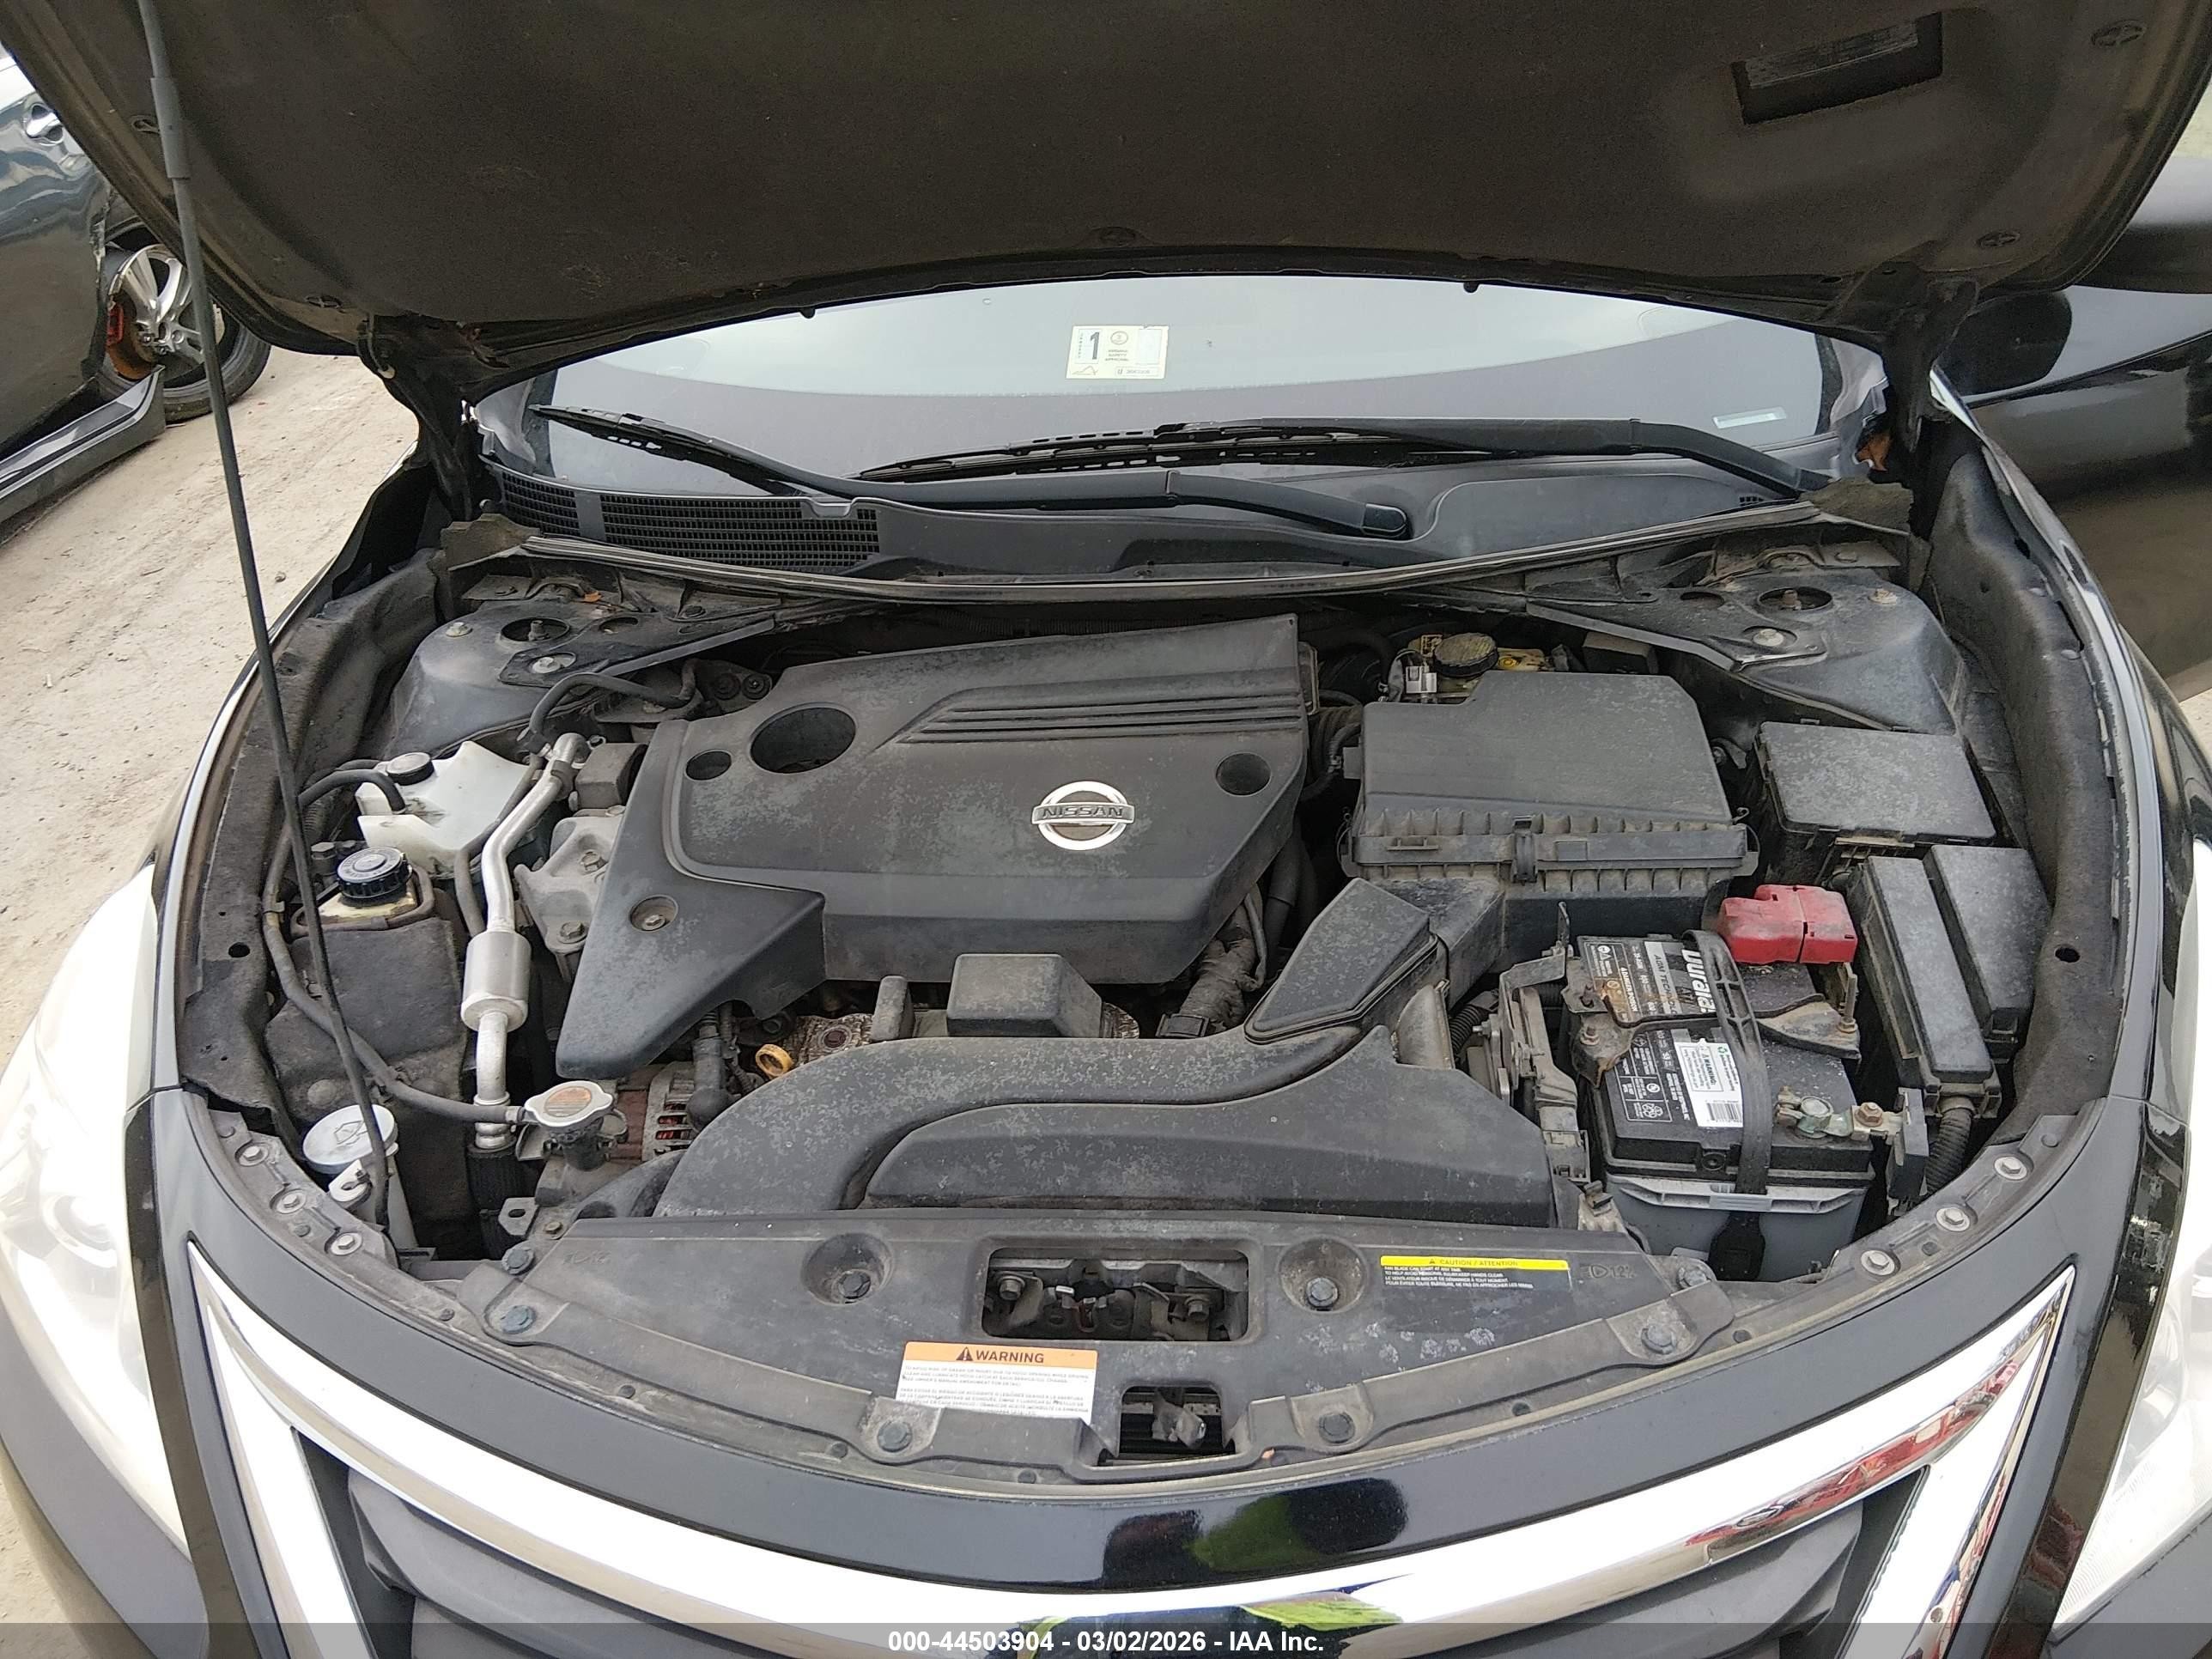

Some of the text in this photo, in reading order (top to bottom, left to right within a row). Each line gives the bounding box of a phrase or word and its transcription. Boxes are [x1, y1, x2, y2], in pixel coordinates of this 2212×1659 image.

[1090, 331, 1100, 360] 1
[1042, 805, 1123, 818] NISSAN
[1654, 954, 1666, 973] AGM
[1440, 1258, 1471, 1267] CAUTION
[975, 1350, 1044, 1364] WARNING
